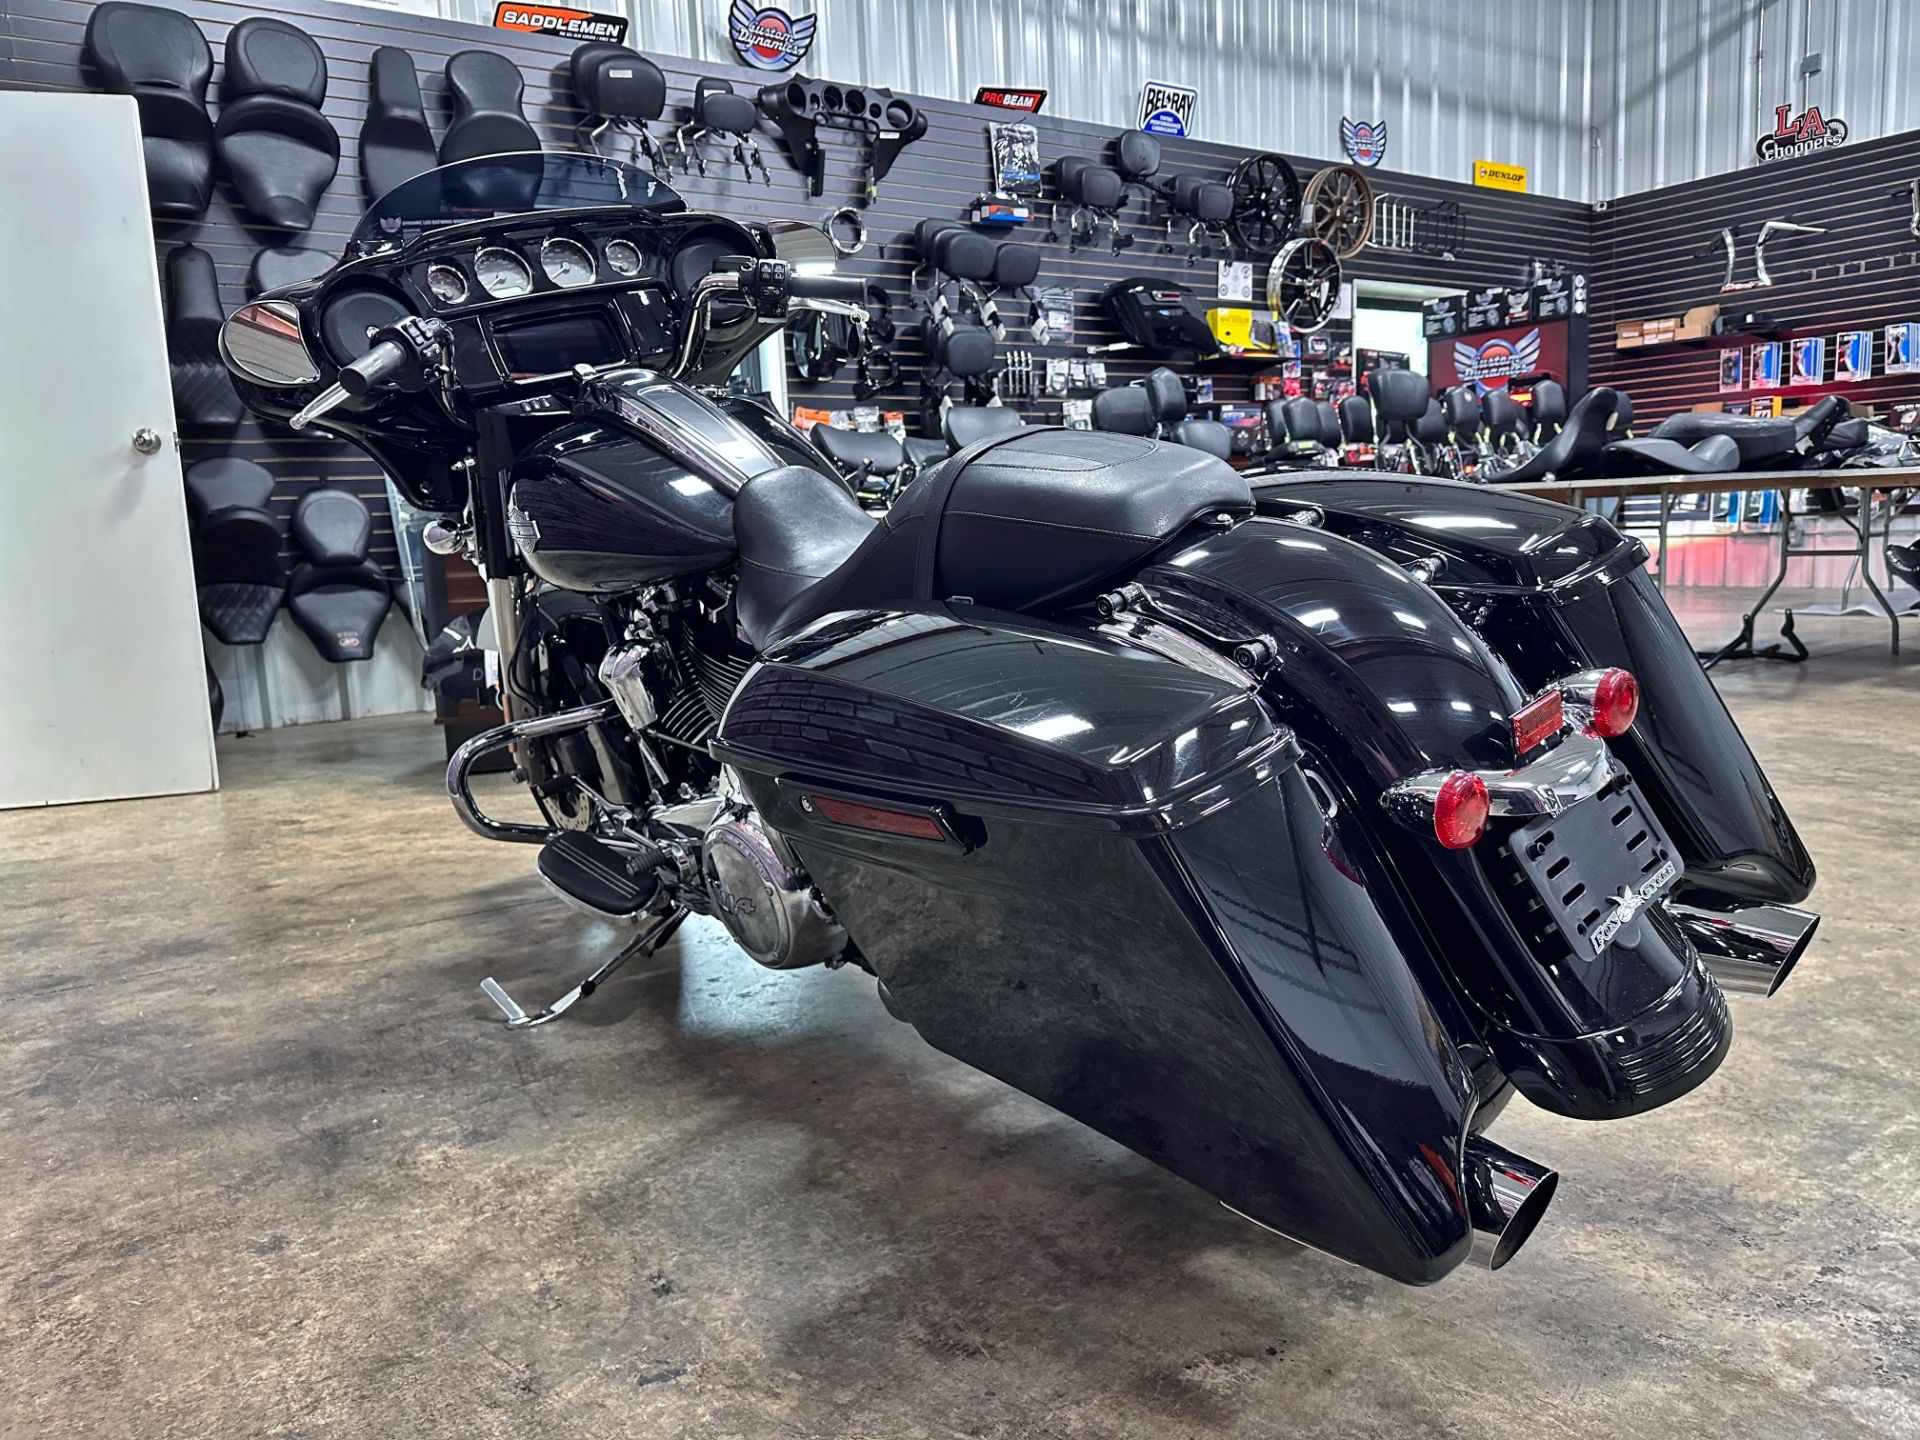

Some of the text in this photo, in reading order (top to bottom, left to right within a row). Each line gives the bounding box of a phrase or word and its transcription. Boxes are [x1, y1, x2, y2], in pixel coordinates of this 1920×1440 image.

[503, 10, 620, 37] SADDLEMEN
[748, 21, 795, 43] Custom
[738, 28, 800, 55] Dynamics
[982, 92, 1034, 108] PROBEAM
[1775, 104, 1827, 139] LA
[1761, 133, 1844, 161] Choppers
[1487, 169, 1524, 182] DUNLOP
[1463, 363, 1527, 381] Dynamics
[1473, 354, 1521, 369] Custom
